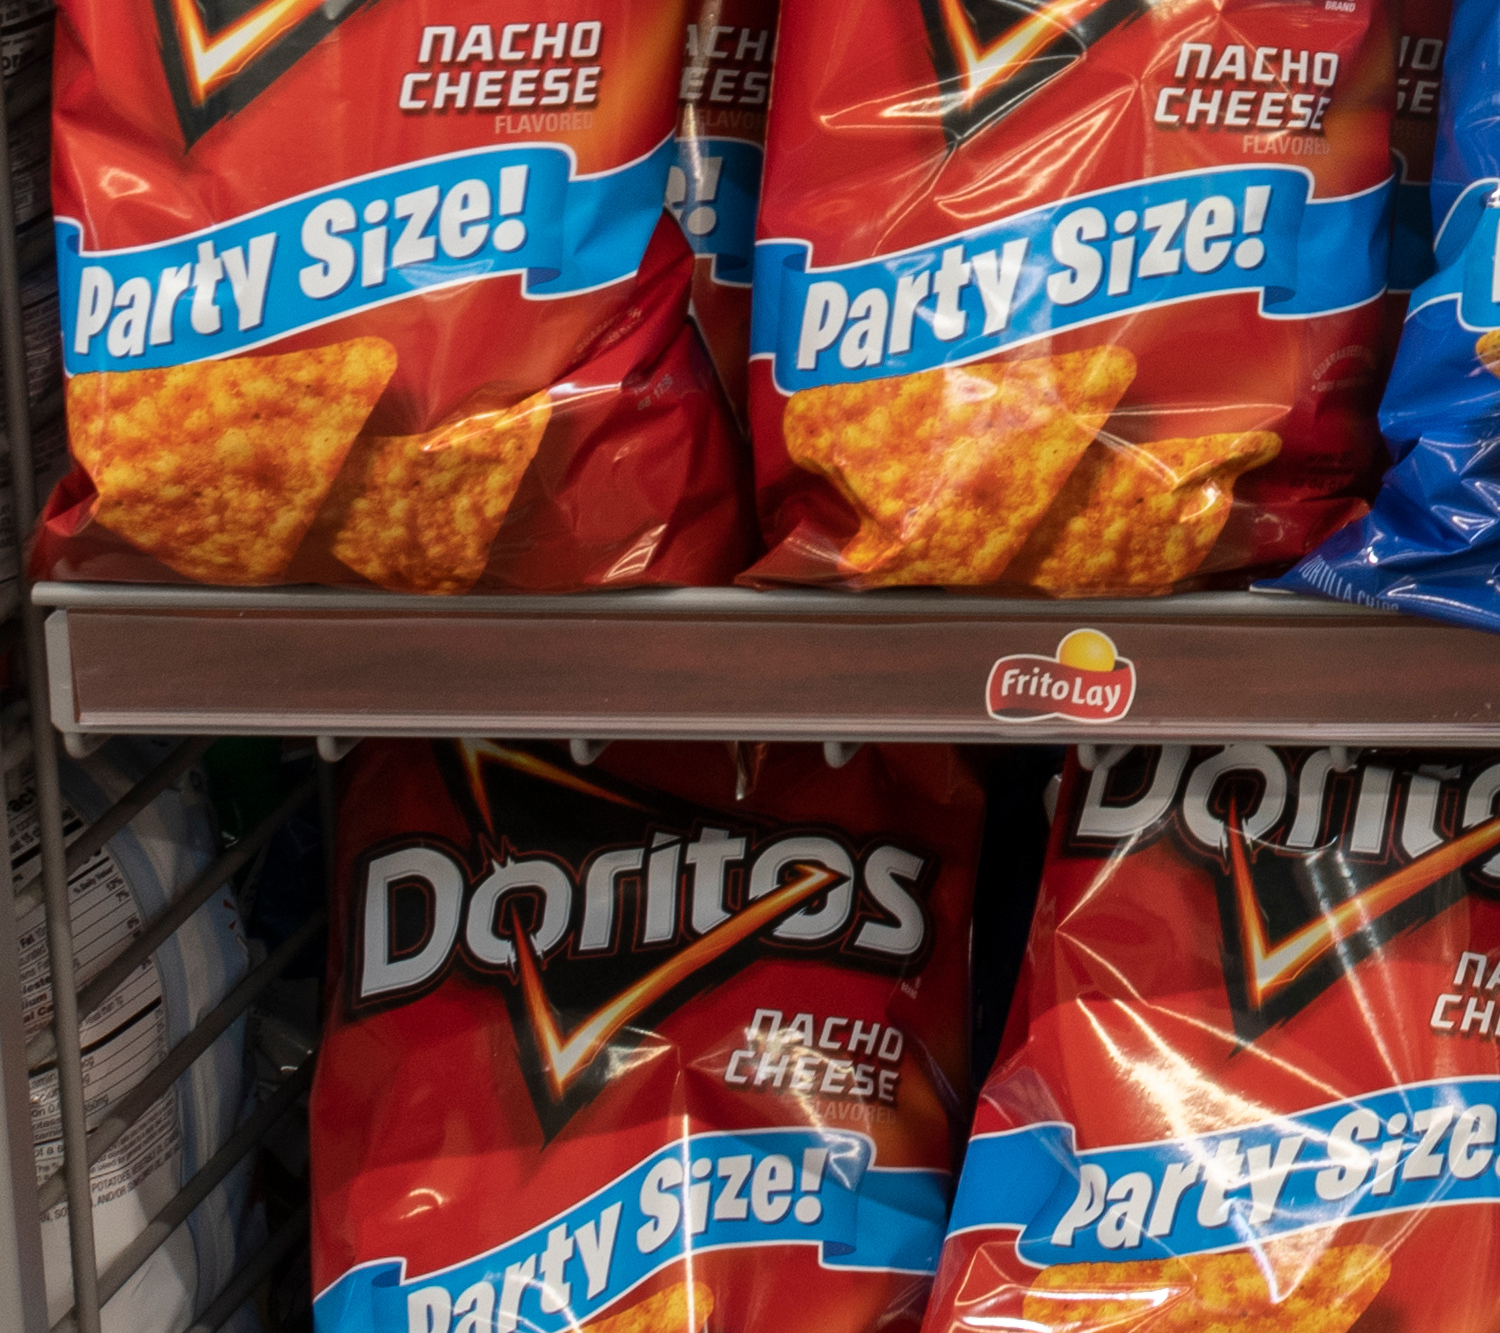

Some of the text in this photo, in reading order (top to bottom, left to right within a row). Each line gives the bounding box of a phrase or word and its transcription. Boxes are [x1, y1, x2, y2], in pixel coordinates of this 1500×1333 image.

[419, 21, 602, 66] NACHO
[1175, 42, 1338, 86] NACHO
[400, 67, 601, 111] CHEESE
[1155, 87, 1331, 131] CHEESE
[74, 164, 528, 359] Party Size!
[797, 185, 1272, 371] Party Size!
[361, 830, 927, 1000] Doritos
[746, 1008, 905, 1063] NACHO
[724, 1048, 899, 1103] CHEESE
[407, 1146, 830, 1333] Party Size!
